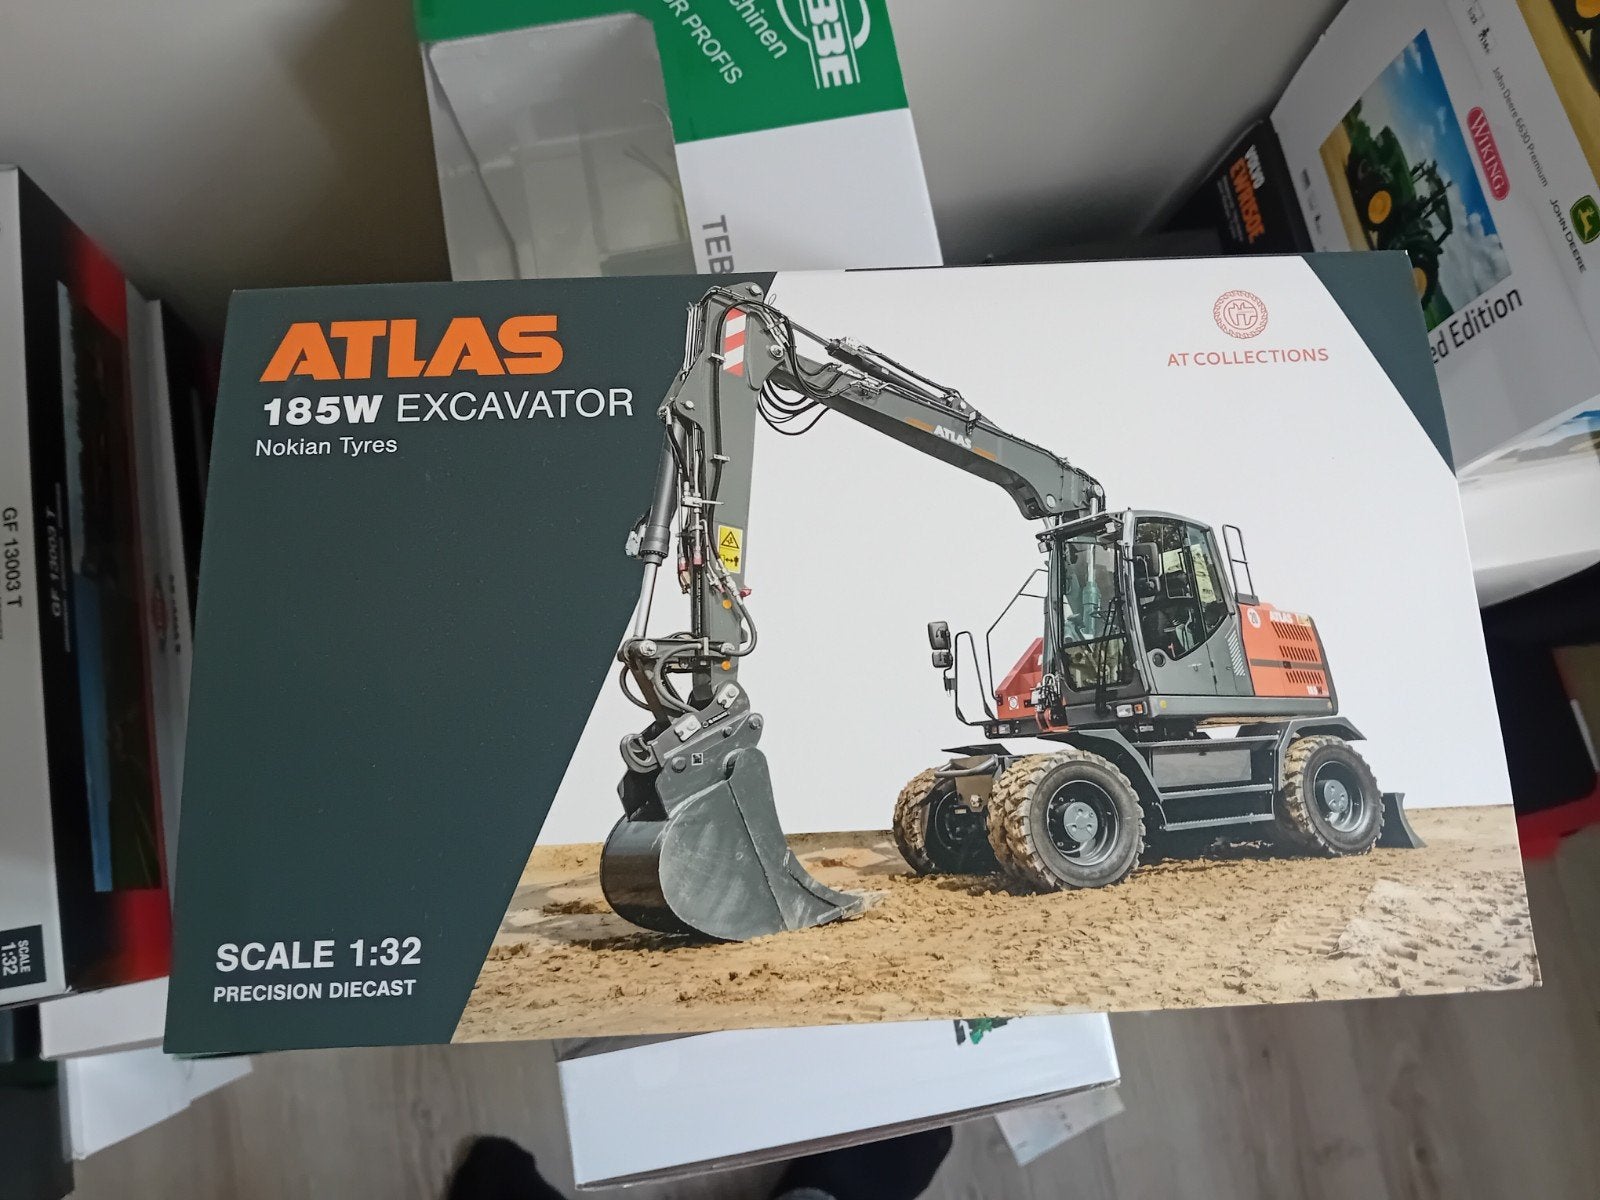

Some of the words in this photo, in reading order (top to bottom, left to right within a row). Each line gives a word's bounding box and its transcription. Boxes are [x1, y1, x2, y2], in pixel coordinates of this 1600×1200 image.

[663, 0, 689, 17] R
[682, 14, 743, 84] PROFIS
[1493, 67, 1505, 88] John
[1503, 88, 1518, 118] Deere
[1515, 116, 1531, 145] 6630
[1527, 142, 1549, 188] Premium
[1469, 112, 1506, 195] WIKING
[702, 214, 735, 274] TEB
[1550, 198, 1568, 232] JOHN
[1565, 230, 1587, 275] DEERE
[1448, 288, 1523, 349] Edition
[259, 314, 565, 383] ATLAS
[1167, 352, 1190, 367] AT
[1192, 347, 1330, 366] COLLECTIONS
[263, 394, 384, 426] 185W
[396, 387, 634, 423] EXCAVATOR
[255, 438, 332, 457] Nokian
[338, 436, 399, 458] Tyres
[933, 424, 973, 450] ATLAS
[2, 506, 19, 533] GF
[4, 538, 21, 592] 13003
[6, 595, 23, 608] T
[1, 941, 19, 977] 1:32
[18, 939, 31, 973] SCALE
[215, 939, 336, 972] SCALE
[349, 936, 423, 967] 1:32
[213, 982, 323, 1003] PRECISION
[328, 979, 418, 999] DIECAST
